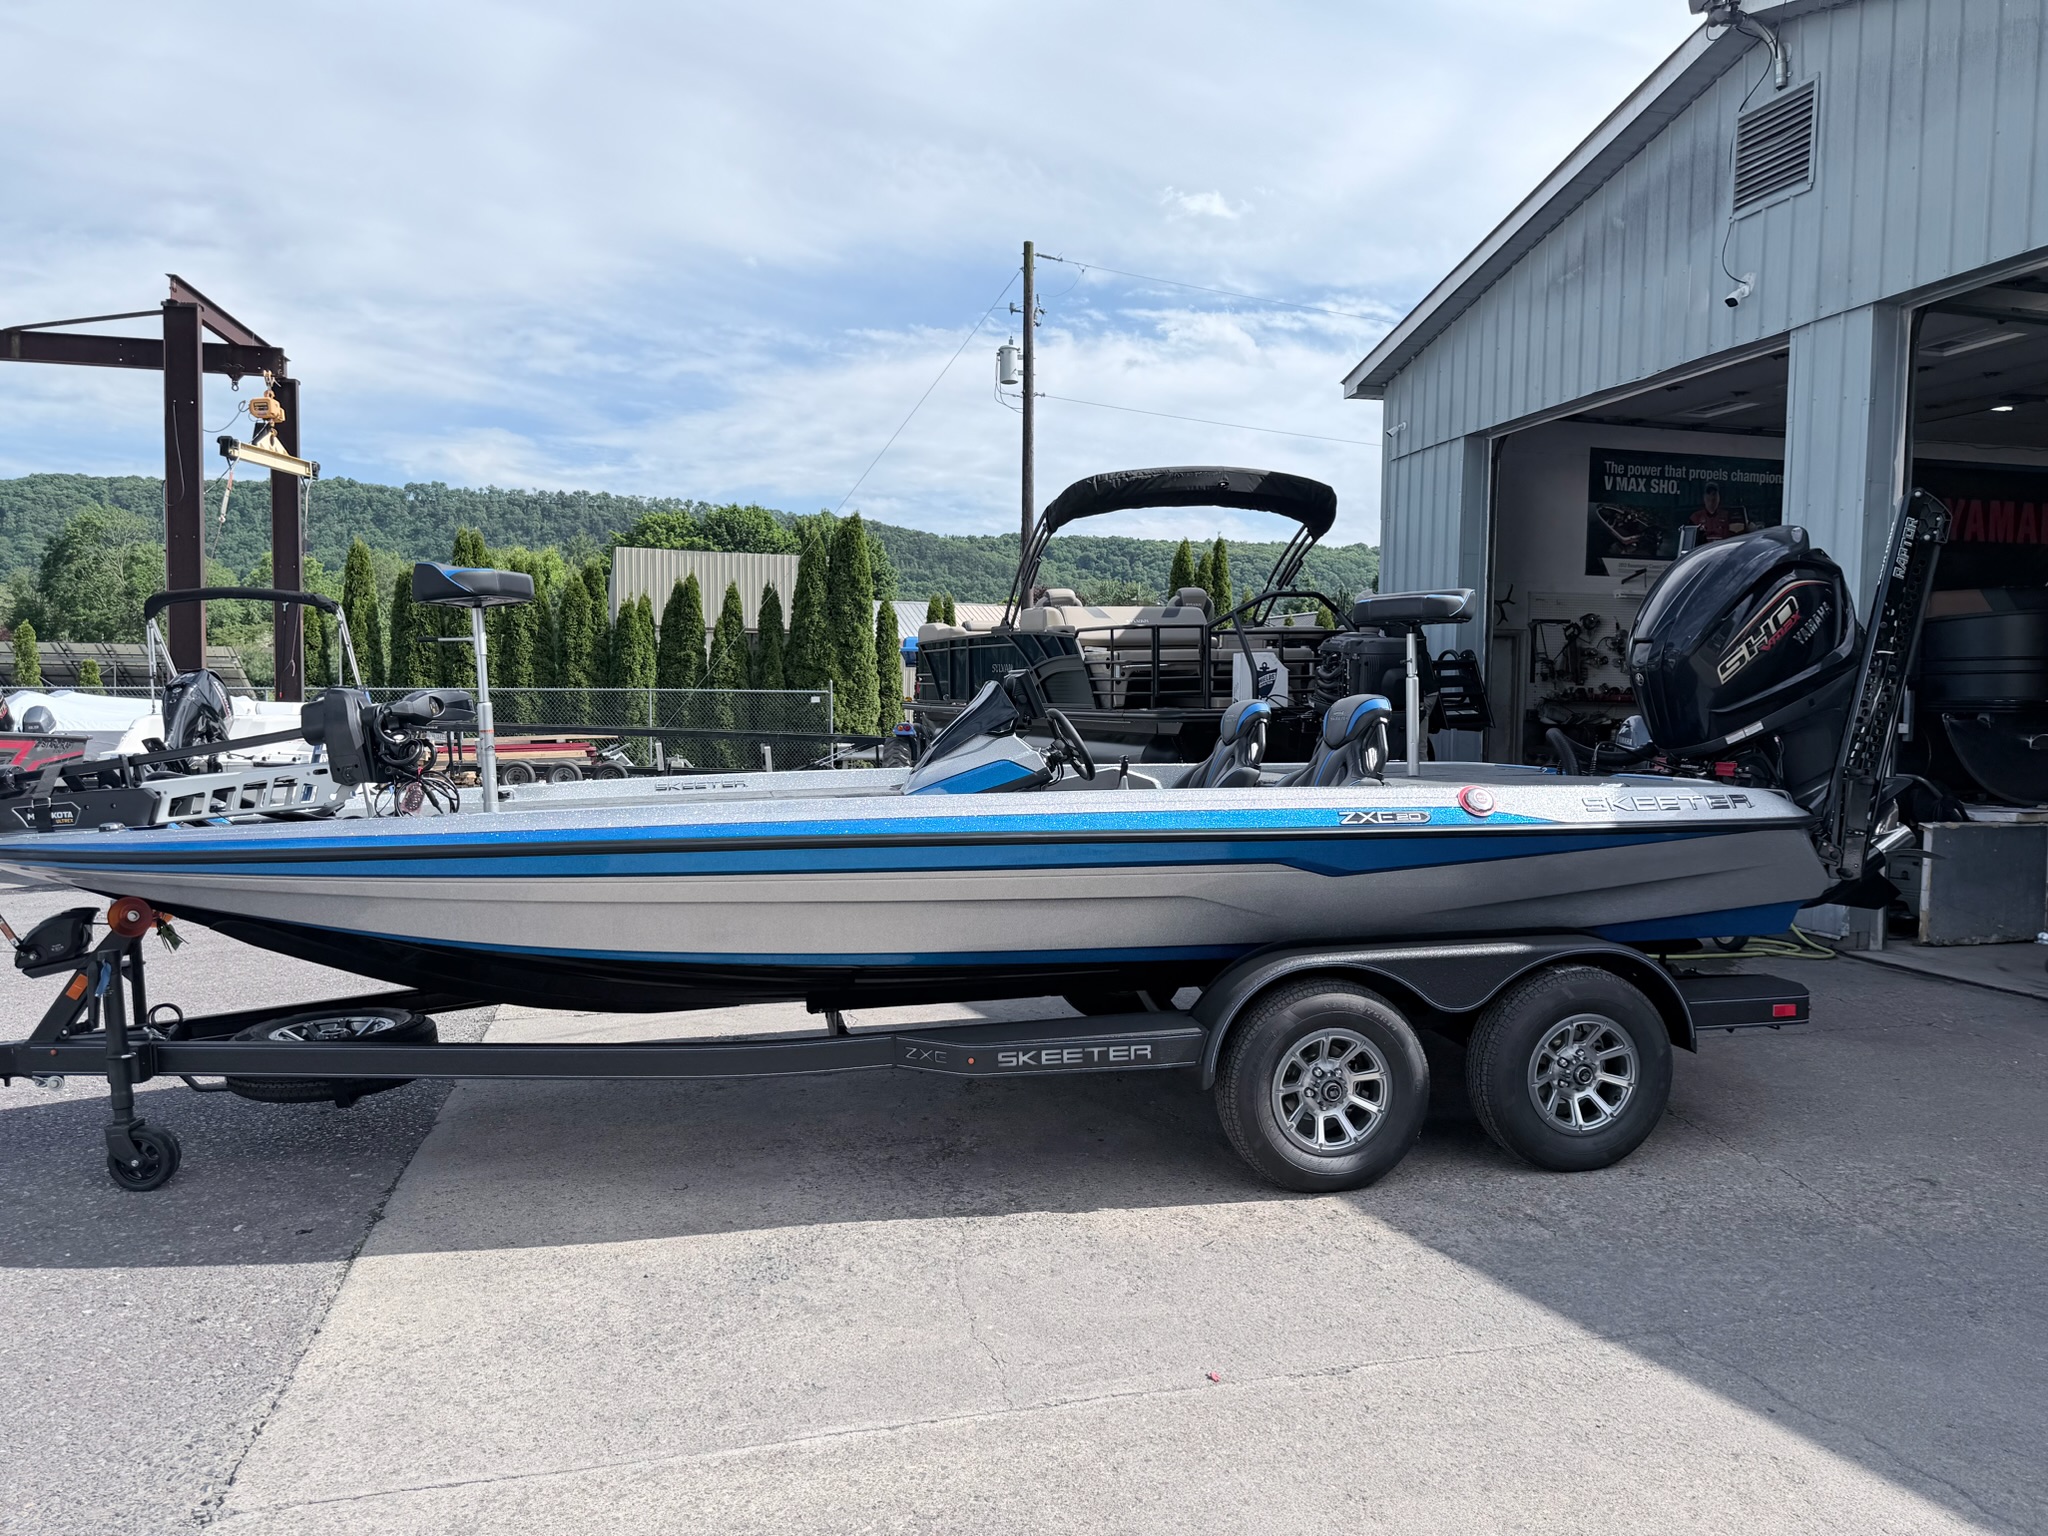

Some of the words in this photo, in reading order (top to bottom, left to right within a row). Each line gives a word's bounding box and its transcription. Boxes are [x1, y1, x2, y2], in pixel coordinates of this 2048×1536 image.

[1604, 460, 1624, 474] The
[1628, 464, 1662, 477] power
[1664, 465, 1686, 478] that
[1689, 468, 1728, 481] propels
[1616, 476, 1646, 492] MAX
[1651, 478, 1680, 494] SHO.
[1943, 498, 2048, 545] YAMA
[1892, 516, 1919, 580] RAPTOR
[1793, 601, 1832, 645] YAMAHA
[1717, 595, 1799, 685] SHO
[655, 780, 747, 792] SKEETER
[1582, 794, 1753, 812] SKEETER
[51, 811, 73, 819] KOTA
[905, 1046, 948, 1064] ZXE
[998, 1044, 1152, 1067] SKEETER
